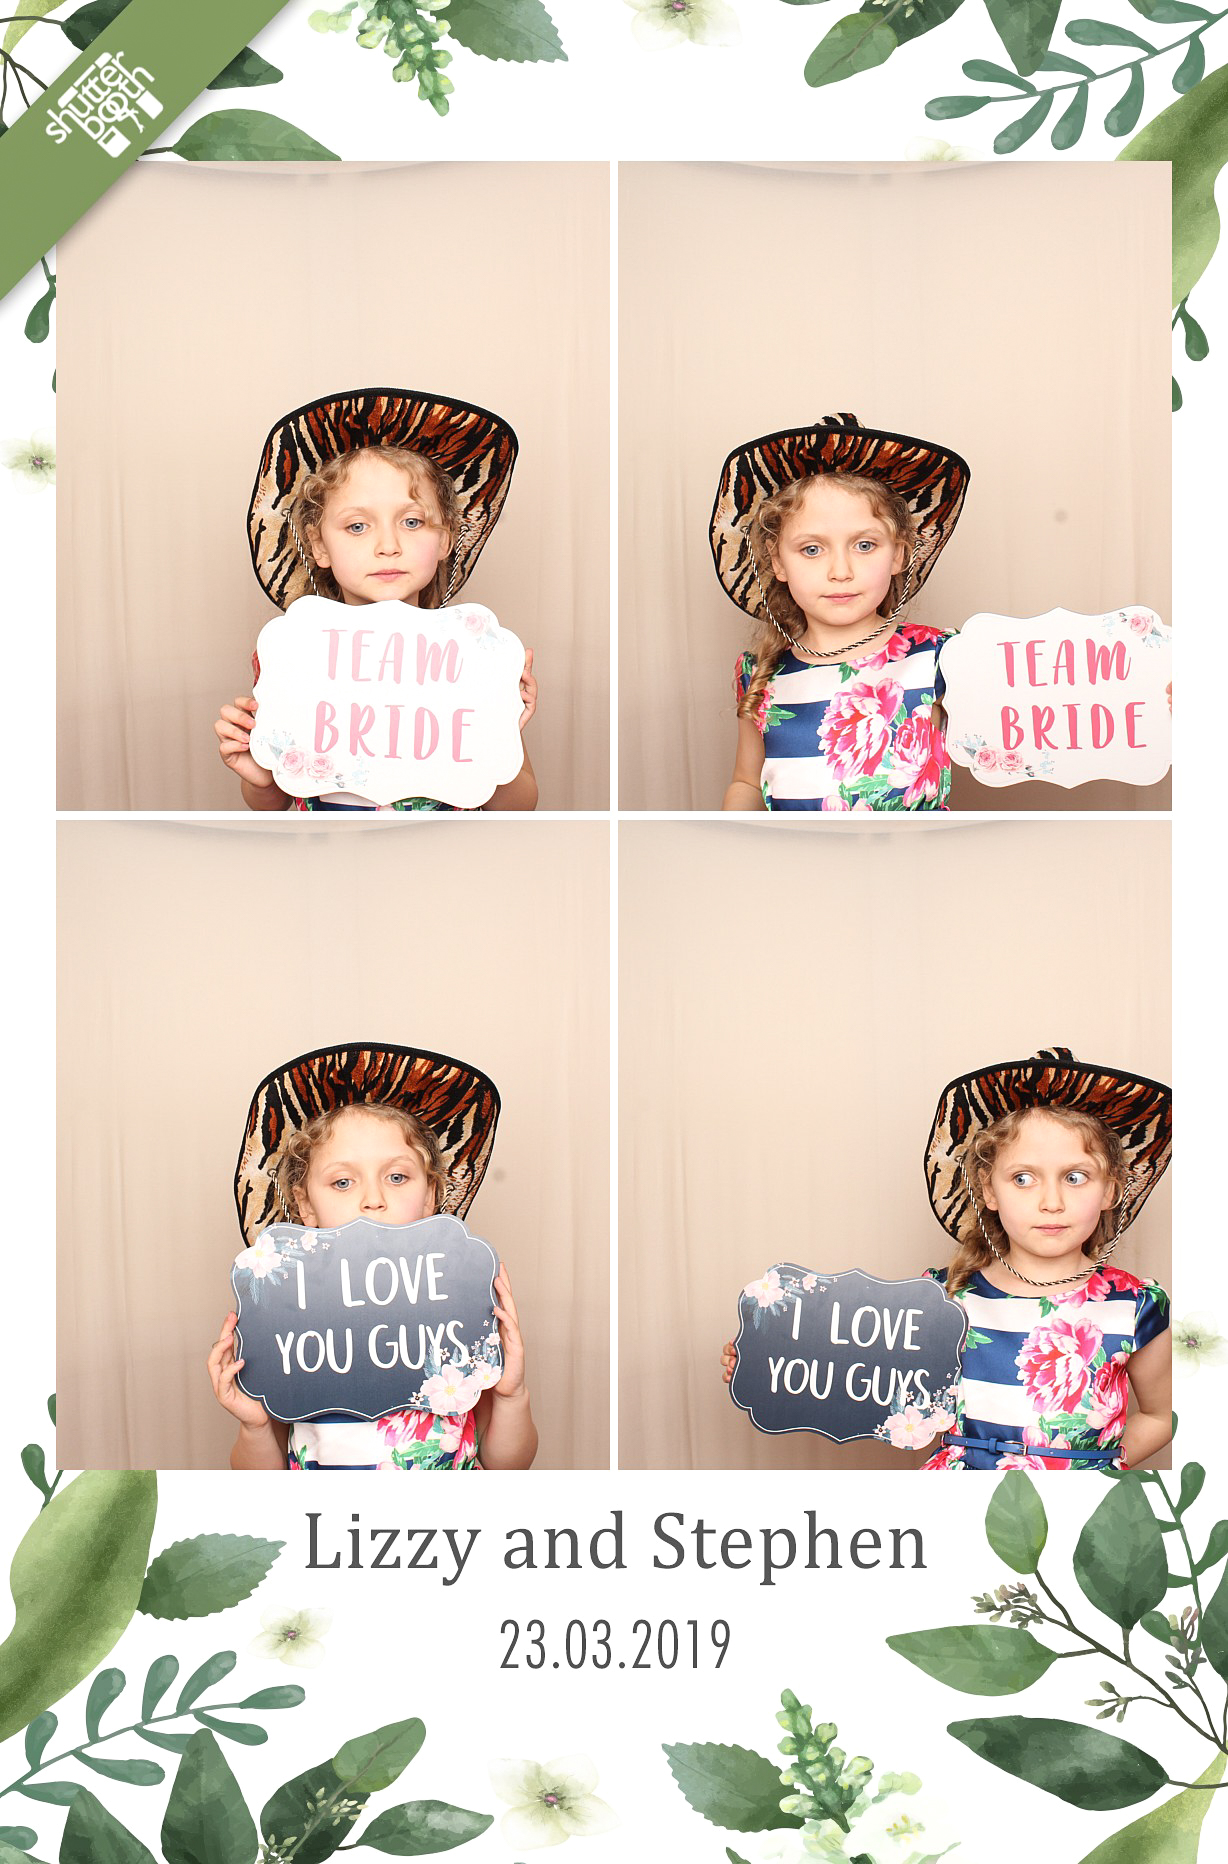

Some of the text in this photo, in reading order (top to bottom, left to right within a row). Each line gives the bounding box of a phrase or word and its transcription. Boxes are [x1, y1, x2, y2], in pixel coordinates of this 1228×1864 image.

[322, 628, 463, 685] TEAM
[997, 638, 1131, 687] TEAM
[314, 701, 475, 763] BRIDE
[1001, 702, 1147, 750] BRIDE
[296, 1252, 448, 1310] I LOVE
[275, 1320, 469, 1375] YOU GUYS
[792, 1297, 923, 1350] I LOVE
[768, 1356, 930, 1410] YOU GUYS
